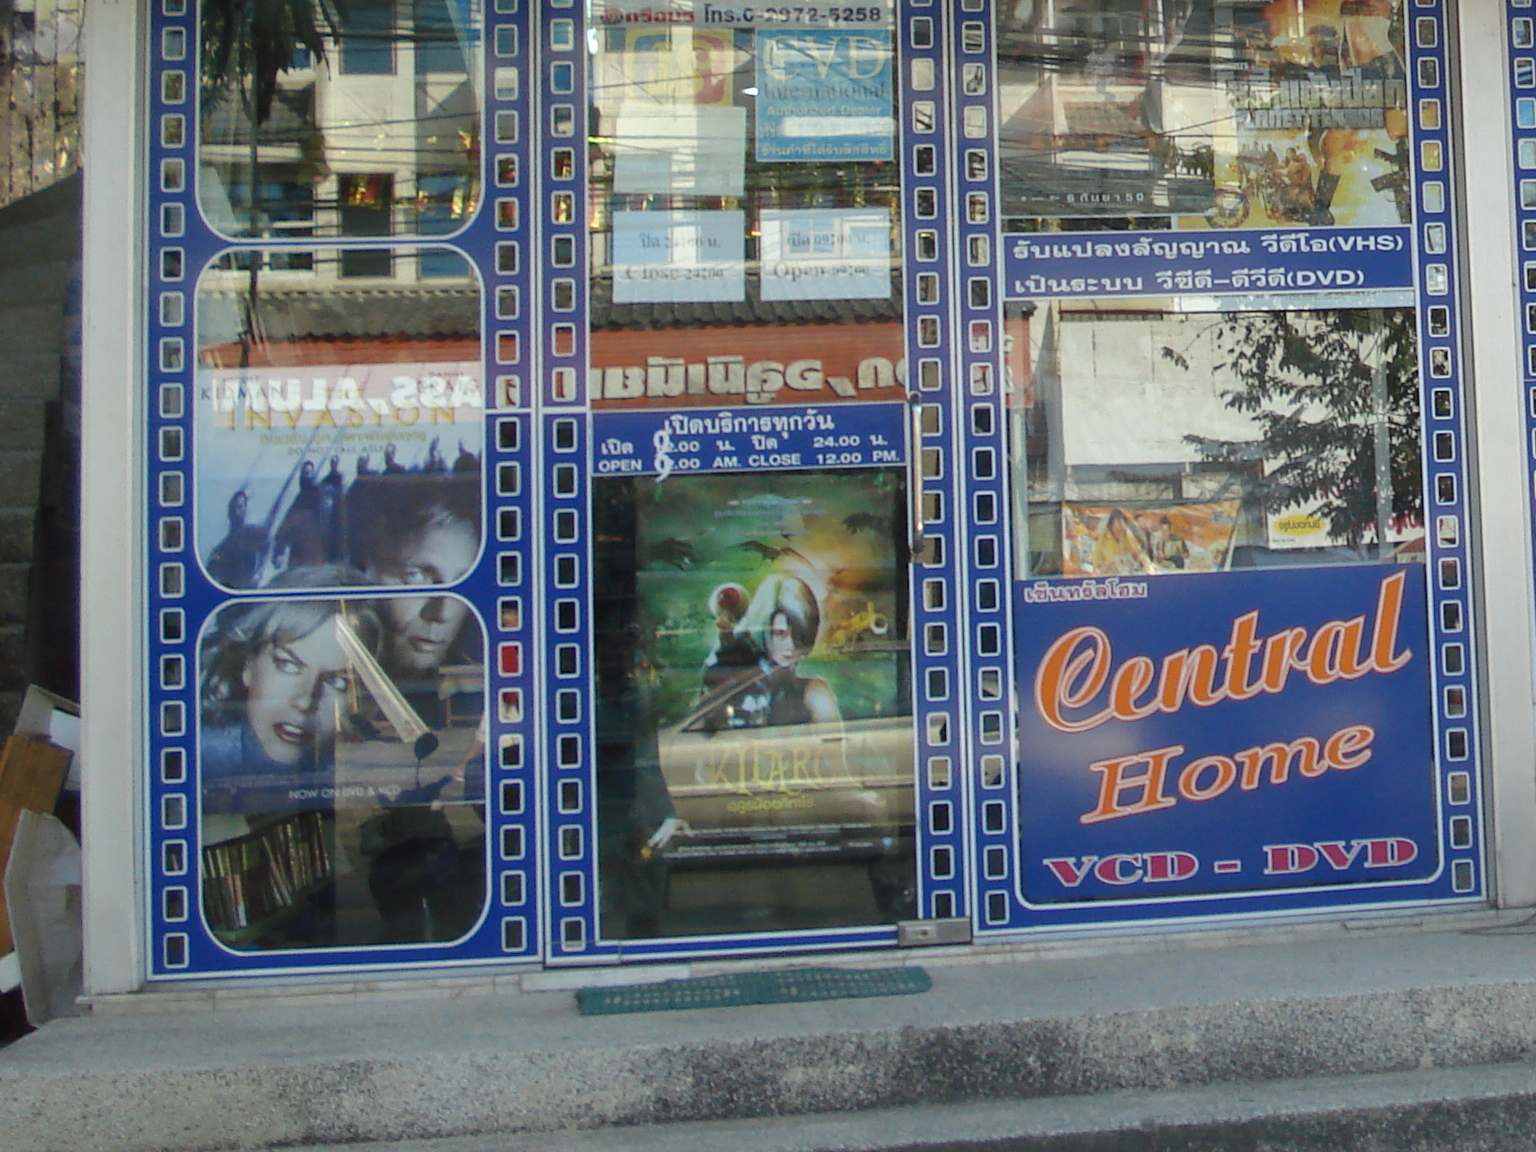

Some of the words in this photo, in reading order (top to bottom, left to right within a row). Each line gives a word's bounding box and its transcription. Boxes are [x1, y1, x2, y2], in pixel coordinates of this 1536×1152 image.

[763, 35, 886, 80] CVD
[1012, 235, 1251, 259] รับแปลงสัญญาณ
[774, 261, 827, 282] Open
[1014, 273, 1143, 294] เป็นระบบ
[664, 409, 835, 440] เปิดบริการทุกวัน
[601, 438, 634, 455] เปิด
[751, 434, 778, 451] ปิด
[813, 435, 861, 449] 24.00
[869, 434, 888, 446] น.
[598, 458, 643, 473] OPEN
[712, 455, 742, 469] AM.
[748, 452, 802, 467] CLOSE
[816, 451, 862, 465] 12.00
[873, 449, 901, 462] PM.
[1035, 569, 1413, 733] Central
[1080, 725, 1375, 824] Home
[1042, 851, 1199, 888] VCD
[1264, 836, 1418, 877] DVD
